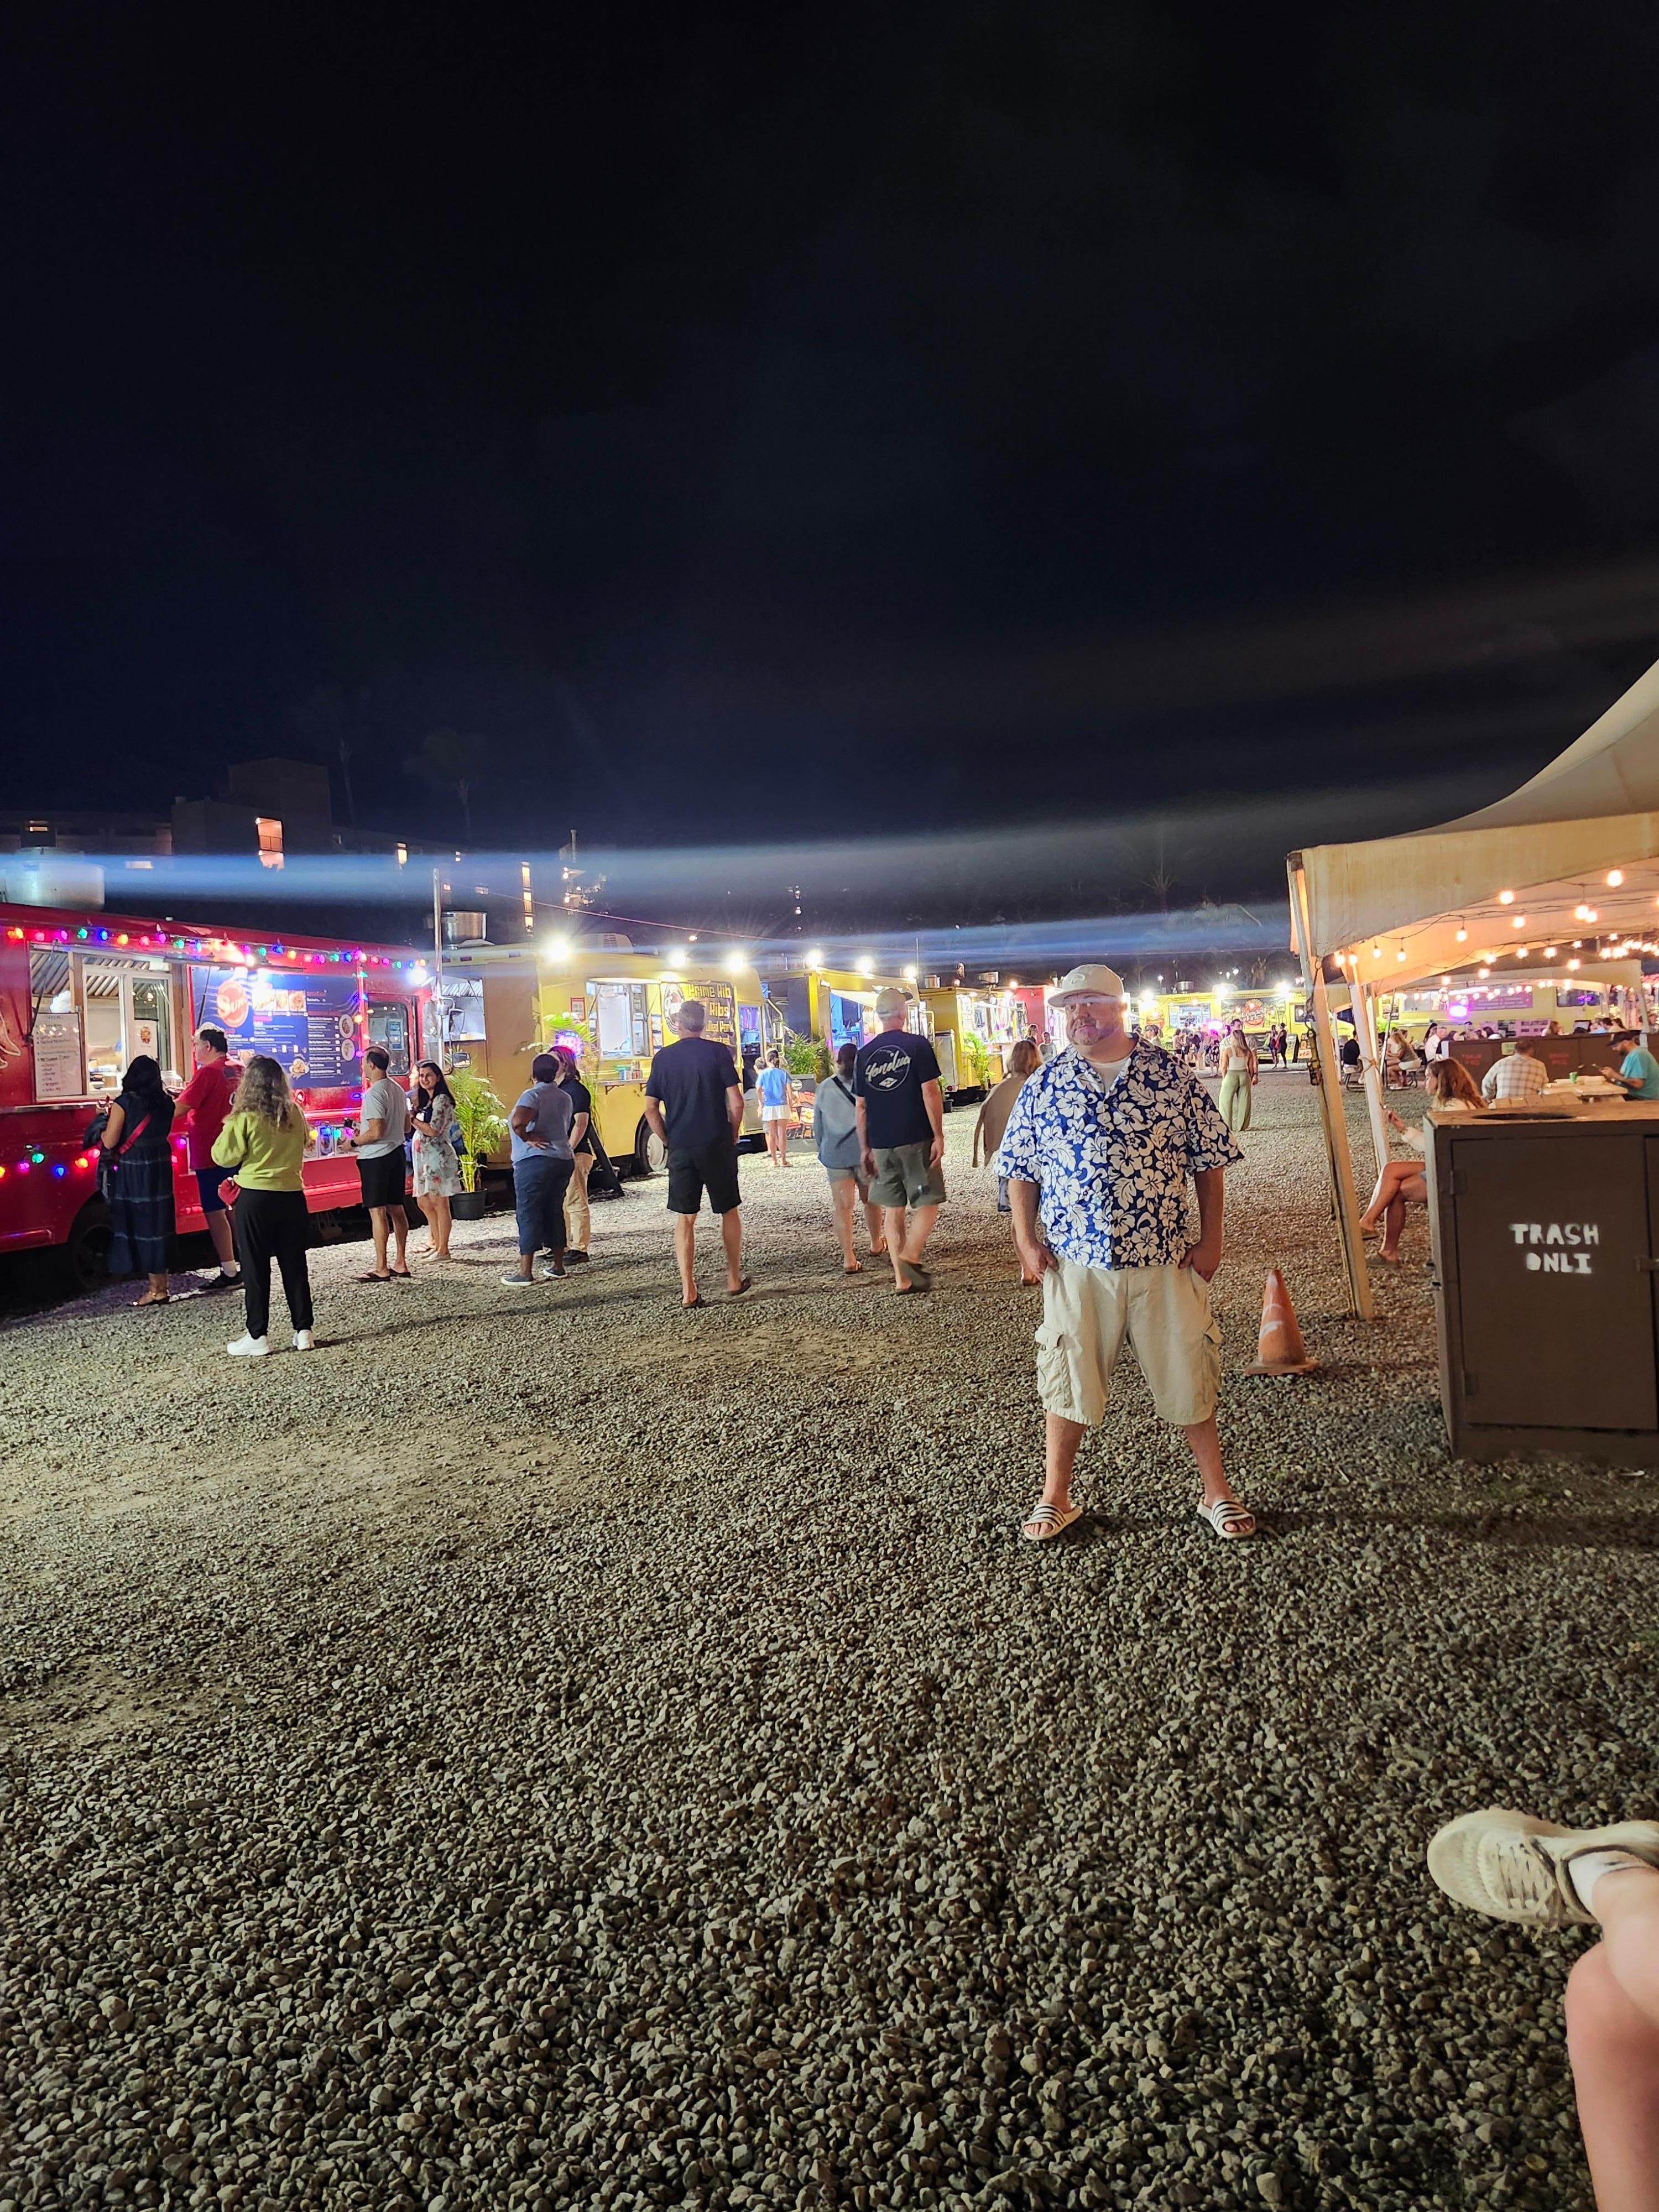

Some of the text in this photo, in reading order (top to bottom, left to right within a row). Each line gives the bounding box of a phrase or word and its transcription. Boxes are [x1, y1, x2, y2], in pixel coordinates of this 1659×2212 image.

[688, 983, 732, 999] Prime Rib
[709, 1001, 731, 1019] Ribs
[705, 1020, 719, 1032] ulled
[1510, 1223, 1599, 1245] TRASH
